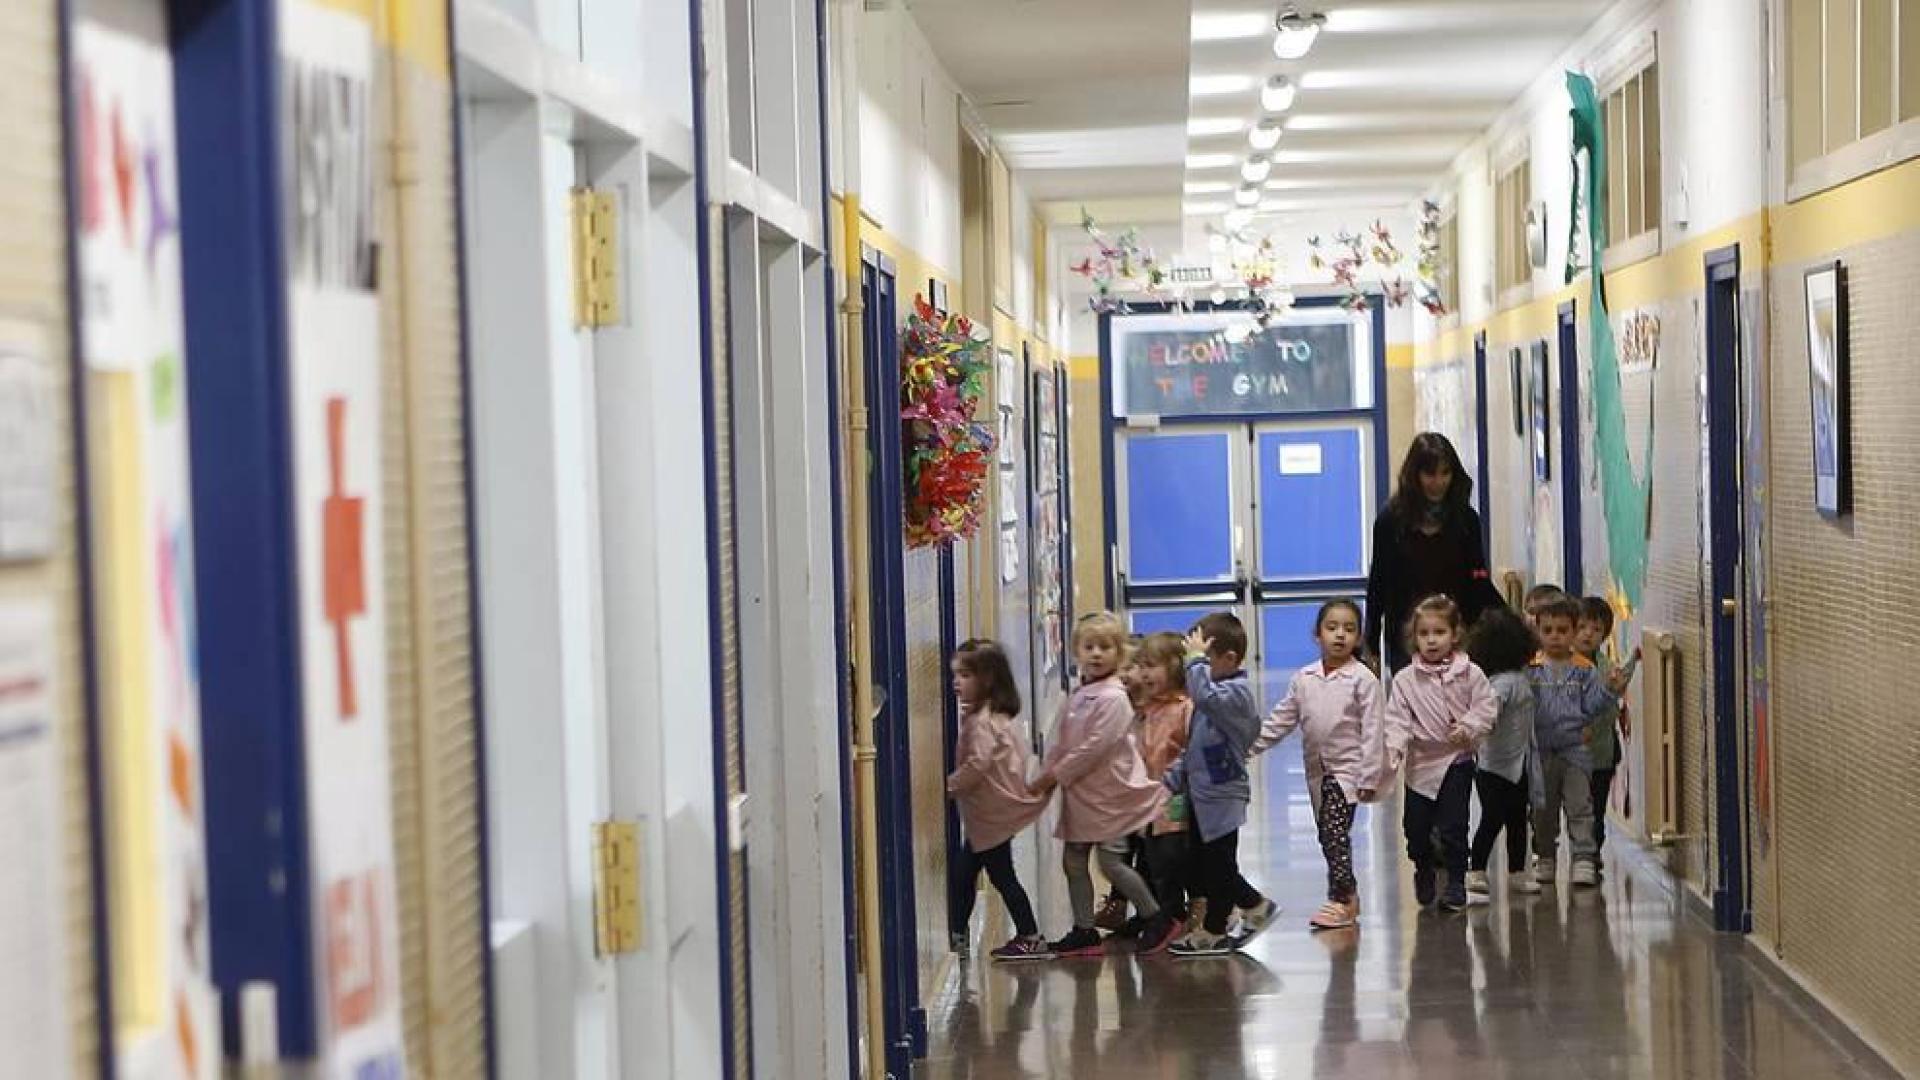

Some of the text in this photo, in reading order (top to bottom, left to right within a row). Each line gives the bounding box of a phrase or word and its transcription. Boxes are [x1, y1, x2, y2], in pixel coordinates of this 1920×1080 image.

[1128, 336, 1311, 366] ELCOME TO
[1154, 373, 1289, 399] TE GYM
